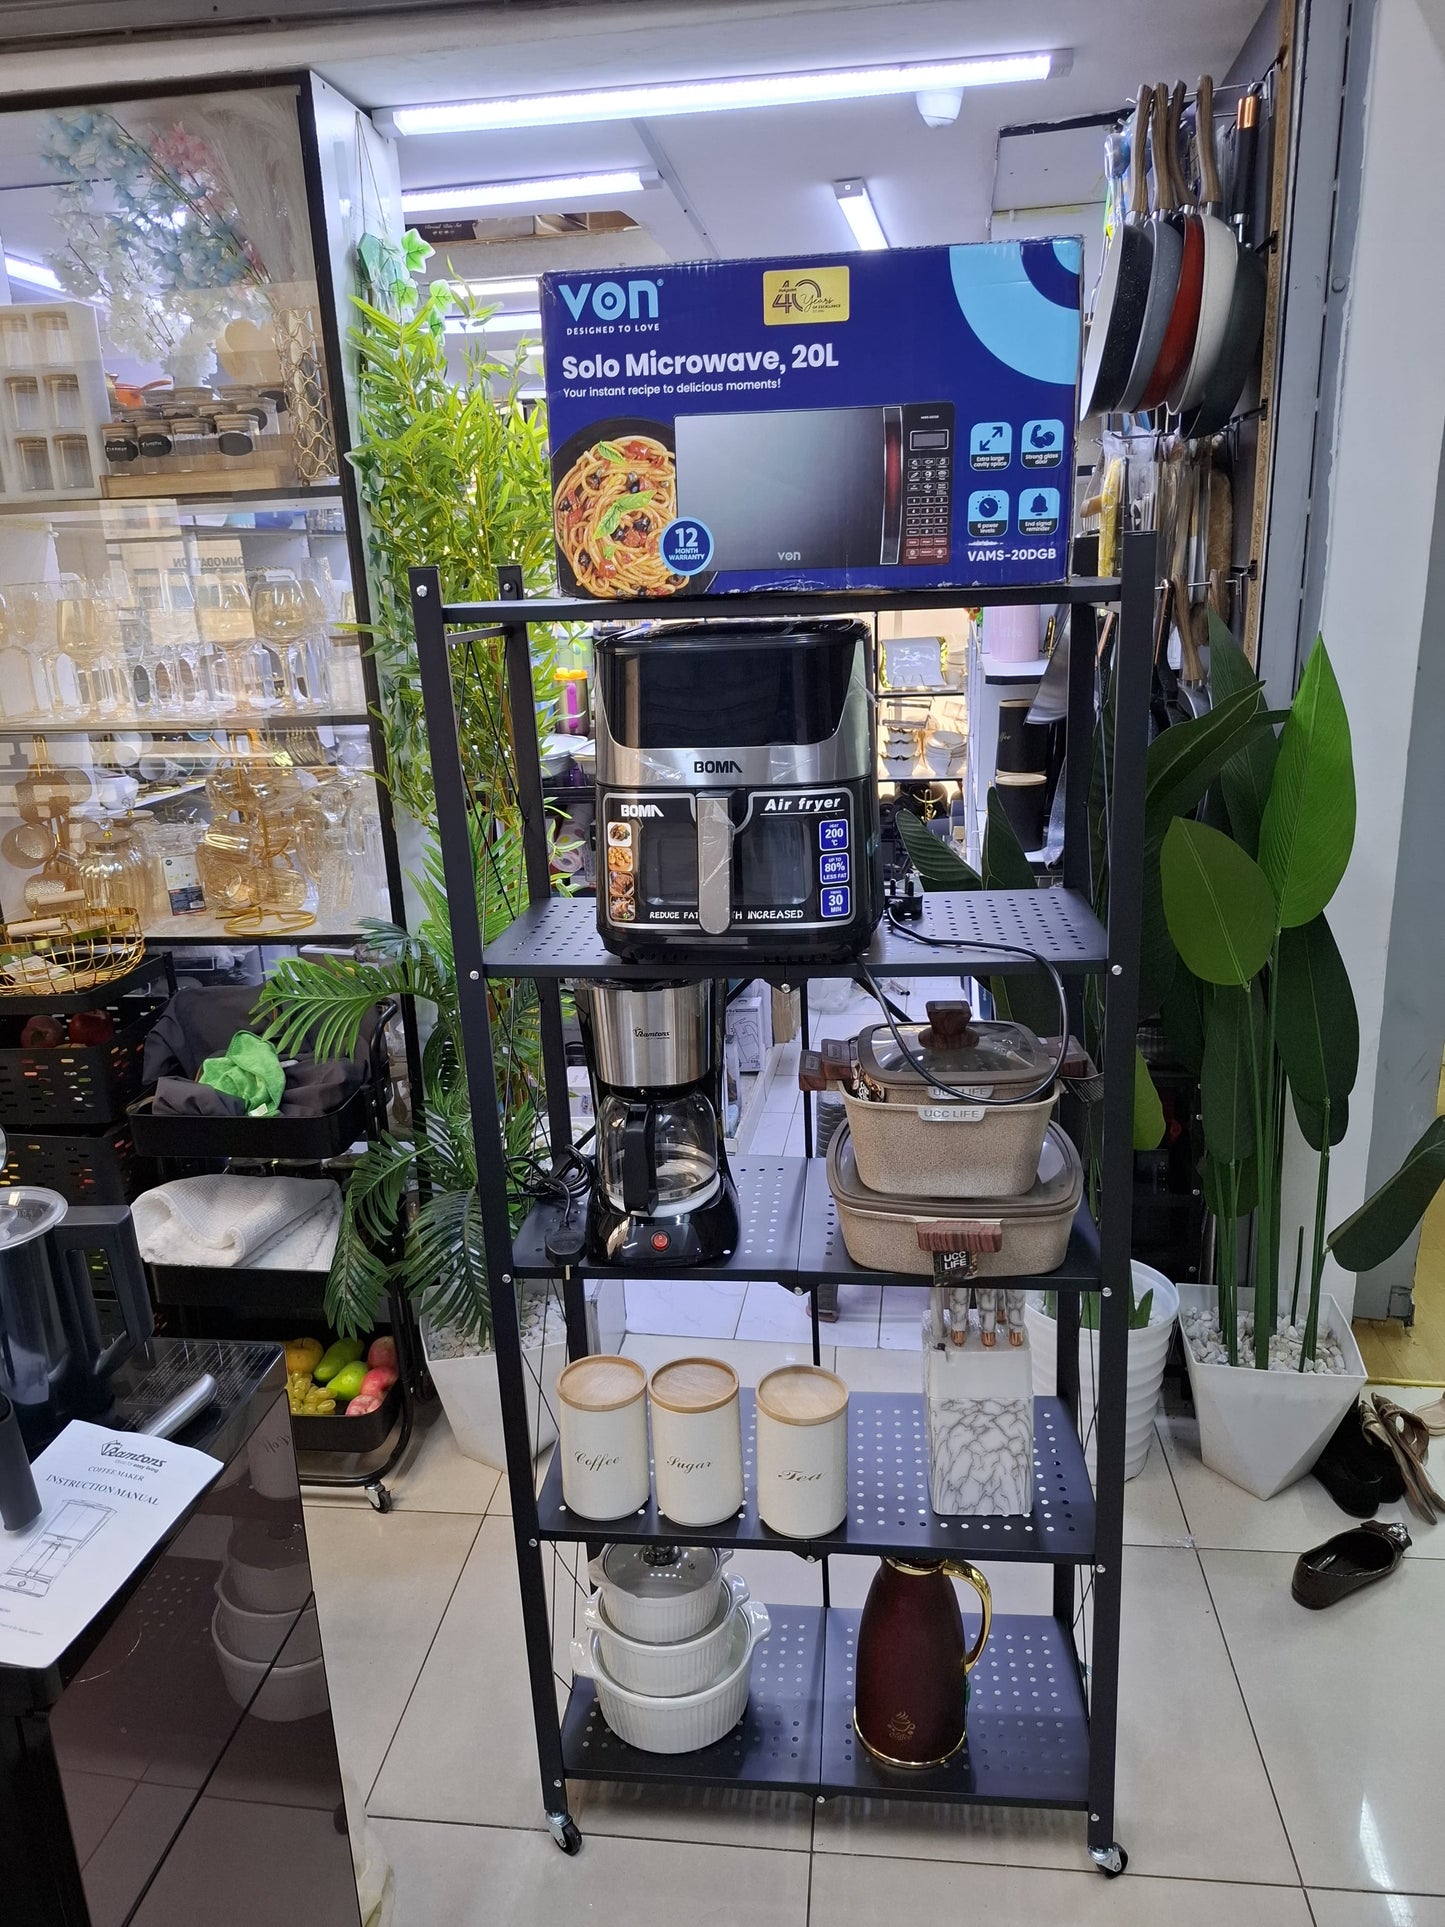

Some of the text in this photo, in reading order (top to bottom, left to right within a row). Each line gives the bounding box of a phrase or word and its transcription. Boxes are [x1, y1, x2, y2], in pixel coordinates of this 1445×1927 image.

[566, 323, 660, 335] DESIGNED TO LOVE
[562, 343, 839, 379] Solo Microwave, 20L
[563, 378, 781, 398] Your instant recipe to delicious moments!
[675, 527, 698, 547] 12
[668, 553, 705, 561] WARRANTY
[967, 548, 1057, 562] VAMS-20DGB
[764, 797, 841, 812] Air fryer
[825, 828, 844, 839] 200
[824, 861, 845, 872] 80%
[828, 894, 843, 906] 30
[649, 911, 680, 919] REDUCE
[747, 909, 804, 920] INCREASED
[924, 1109, 980, 1118] UCC LIFE
[943, 1250, 966, 1262] UCC
[944, 1258, 967, 1270] LIFE
[574, 1450, 621, 1471] Coffee
[666, 1455, 712, 1473] Sugar
[87, 1465, 145, 1482] COFFEE MAKER
[46, 1474, 160, 1506] INSTRUCTION MANUAL
